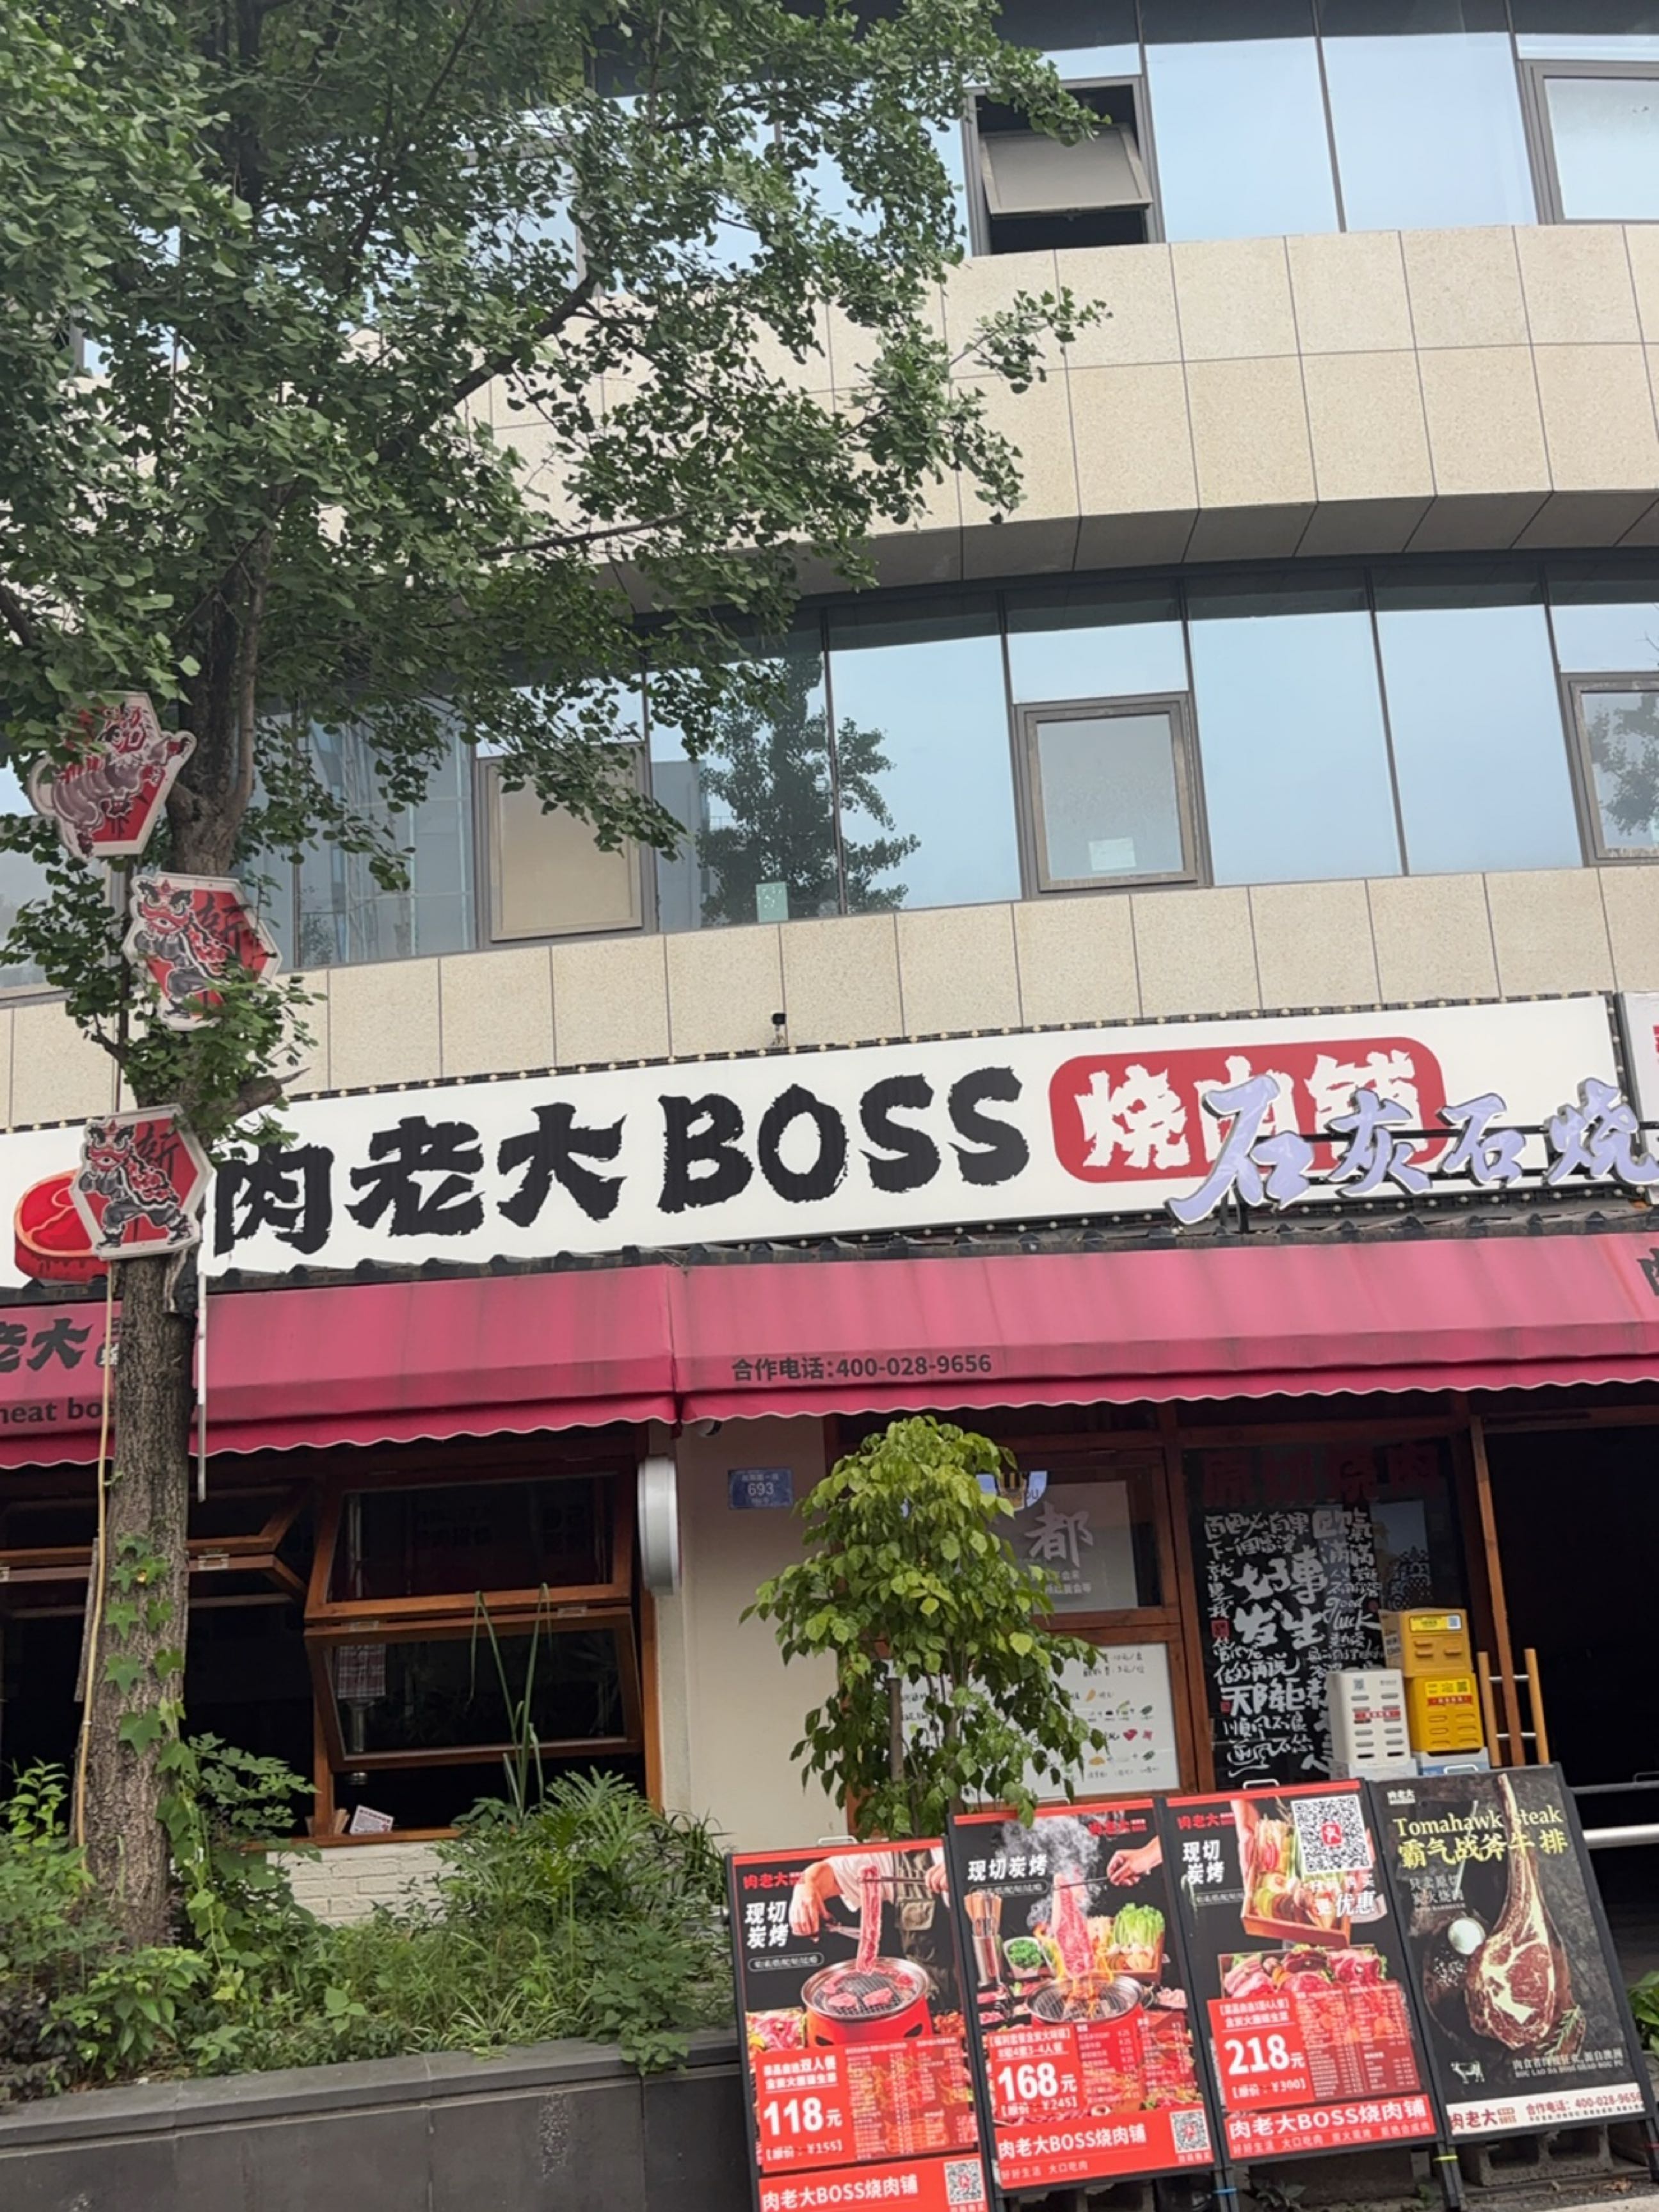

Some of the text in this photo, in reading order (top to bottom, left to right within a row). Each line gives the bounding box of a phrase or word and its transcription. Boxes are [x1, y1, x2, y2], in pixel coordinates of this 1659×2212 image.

[214, 1066, 1030, 1256] 肉老大 BOSS
[747, 1482, 774, 1497] 693
[1392, 1809, 1506, 1837] Tomahawk
[1397, 1828, 1569, 1870] 霸气战斧牛排
[967, 1854, 1048, 1882] 现切炭烤
